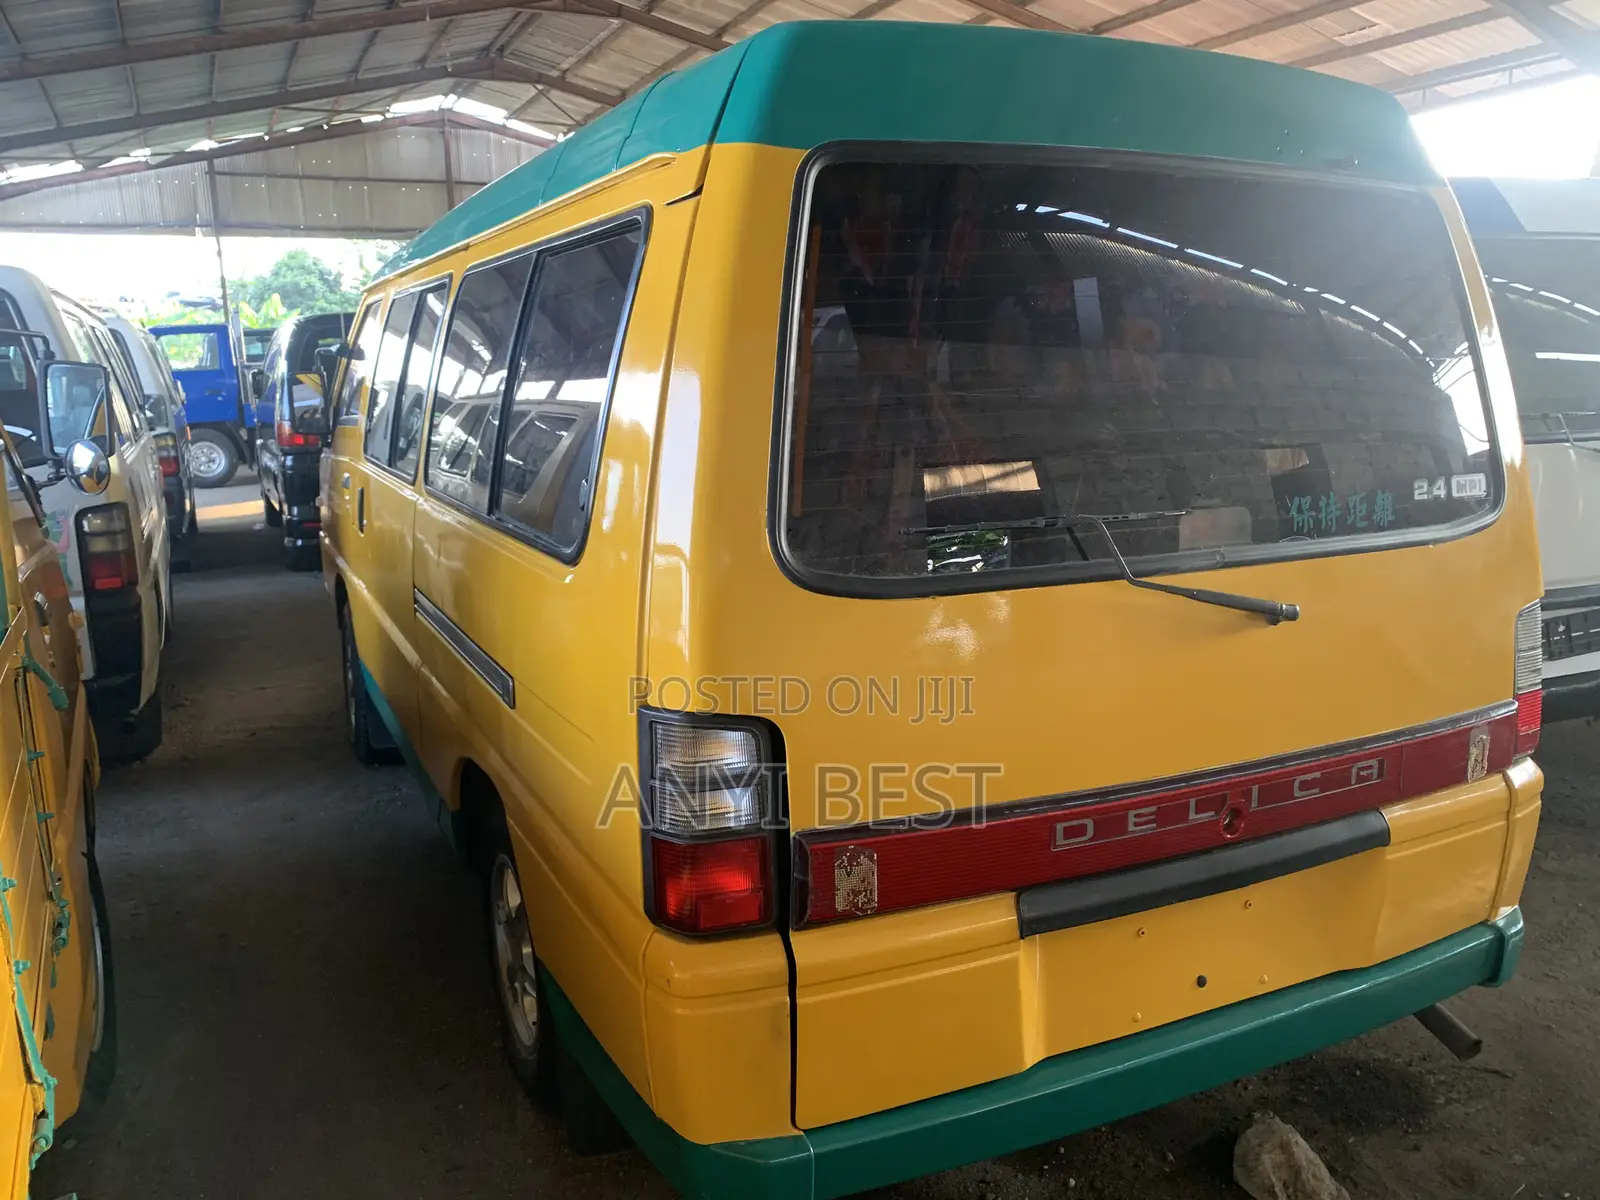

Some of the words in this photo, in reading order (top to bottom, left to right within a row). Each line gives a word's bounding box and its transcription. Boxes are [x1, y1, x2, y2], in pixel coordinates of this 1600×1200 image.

[1290, 490, 1395, 533] 保持距離
[1055, 758, 1379, 845] DELICA
